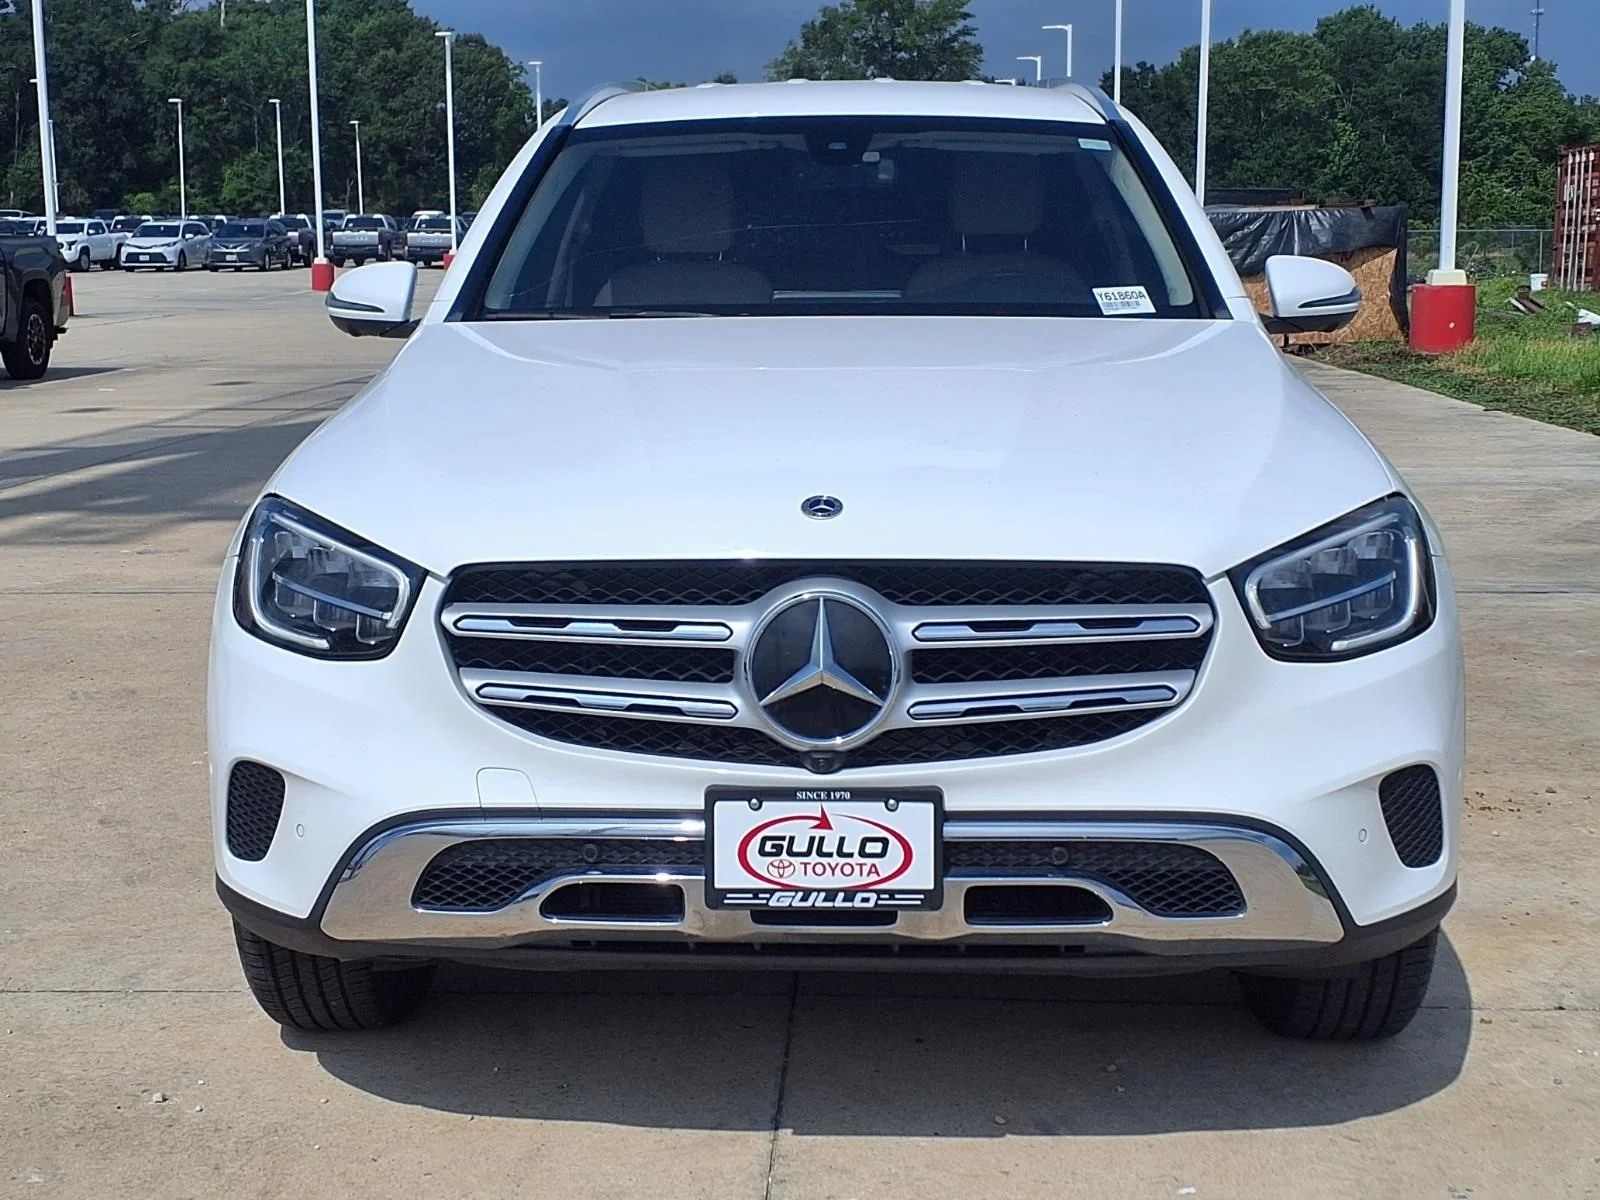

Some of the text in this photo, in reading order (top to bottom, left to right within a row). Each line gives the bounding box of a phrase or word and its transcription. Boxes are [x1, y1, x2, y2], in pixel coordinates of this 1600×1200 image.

[1097, 291, 1146, 301] Y61860A
[796, 791, 851, 800] SINCE 1970
[758, 835, 890, 858] GULLO
[800, 862, 881, 877] TOYOTA
[768, 891, 878, 908] GULLO
